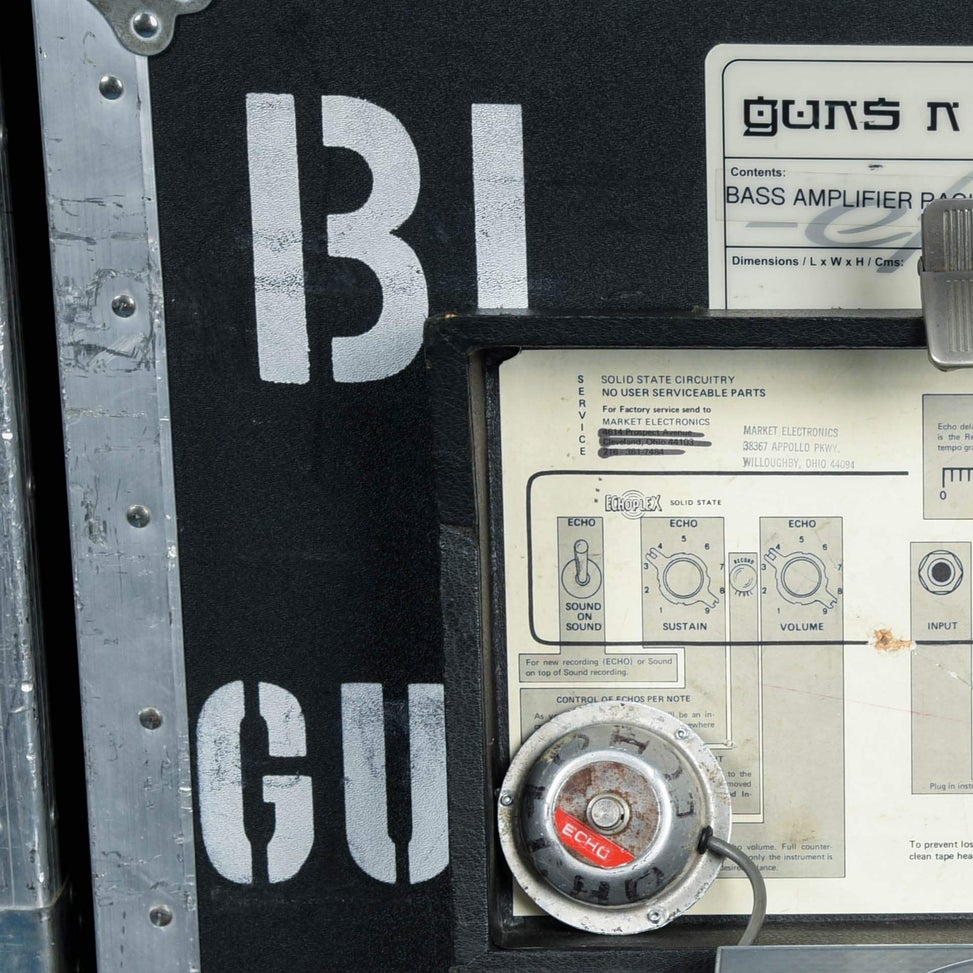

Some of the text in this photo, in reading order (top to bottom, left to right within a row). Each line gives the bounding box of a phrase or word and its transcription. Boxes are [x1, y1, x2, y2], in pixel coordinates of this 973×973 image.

[731, 166, 786, 178] Contents:
[726, 186, 785, 205] BASS
[793, 188, 912, 209] AMPLIFIER
[732, 256, 798, 266] Dimensions
[810, 257, 816, 266] L
[831, 257, 841, 266] W
[856, 258, 863, 266] H
[875, 258, 903, 266] Cms:
[602, 376, 734, 384] SOLID STATE CIRCUITRY
[602, 388, 766, 397] NO USER SERVICEABLE PARTS
[620, 406, 650, 415] Factory
[743, 426, 838, 437] MARKET ELECTRONICS
[743, 441, 767, 451] 38367
[772, 442, 809, 452] APPOLLO
[940, 491, 946, 500] 0
[605, 495, 662, 512] ECHOPLEX
[568, 519, 595, 527] ECHO
[670, 519, 698, 528] ECHO
[788, 520, 816, 528] ECHO
[565, 603, 601, 611] SOUND
[578, 613, 592, 621] ON
[566, 623, 602, 631] SOUND
[663, 623, 707, 631] SUSTAIN
[780, 623, 824, 631] VOLUME
[928, 621, 957, 631] INPUT
[561, 823, 612, 860] ECHO
[924, 841, 957, 850] prevent
[935, 853, 954, 862] tape
